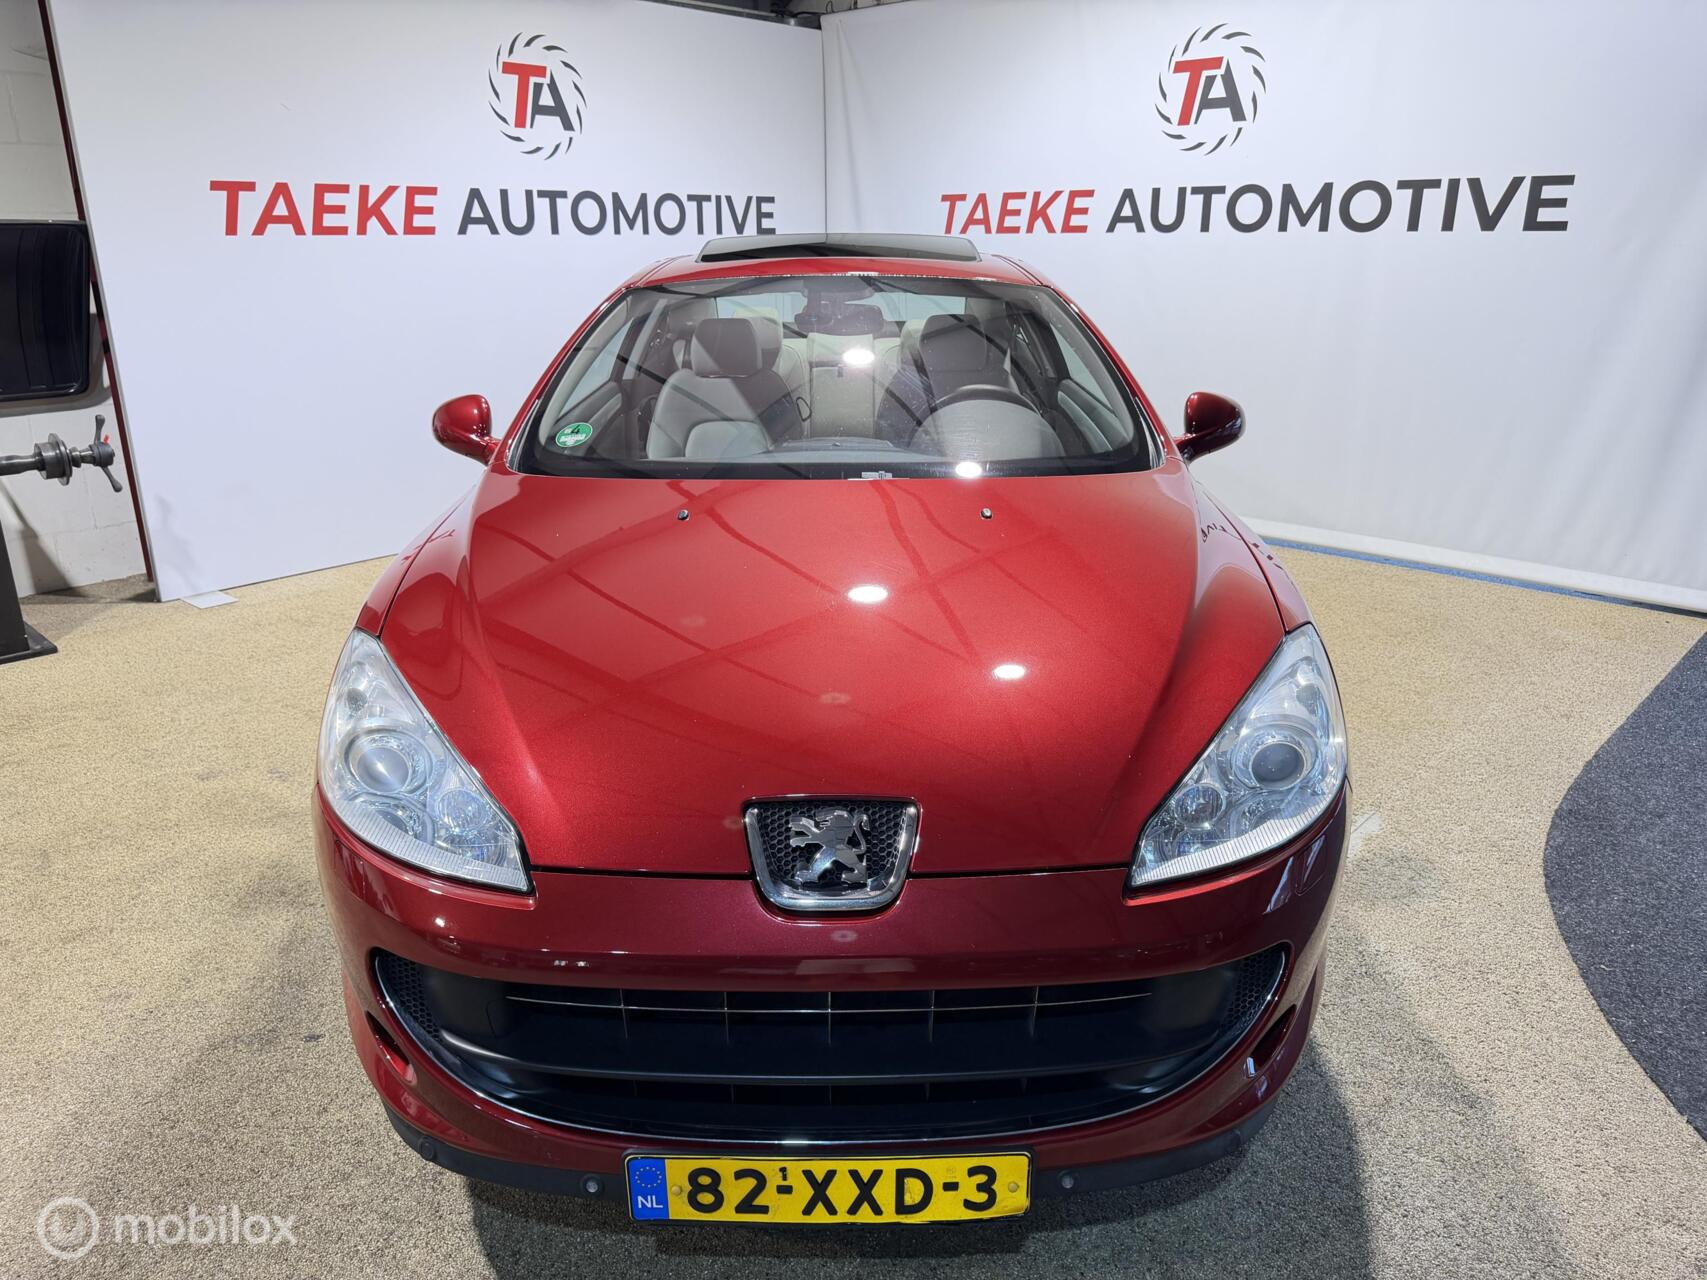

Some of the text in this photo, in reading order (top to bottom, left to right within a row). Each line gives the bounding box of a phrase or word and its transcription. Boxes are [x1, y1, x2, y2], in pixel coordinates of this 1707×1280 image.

[501, 61, 576, 132] TA
[1171, 55, 1247, 126] TA
[209, 180, 777, 236] TAEKE AUTOMOTIVE
[940, 174, 1576, 234] TAEKE AUTOMOTIVE
[637, 1195, 664, 1210] NL
[686, 1165, 998, 1216] 82-XXD-3
